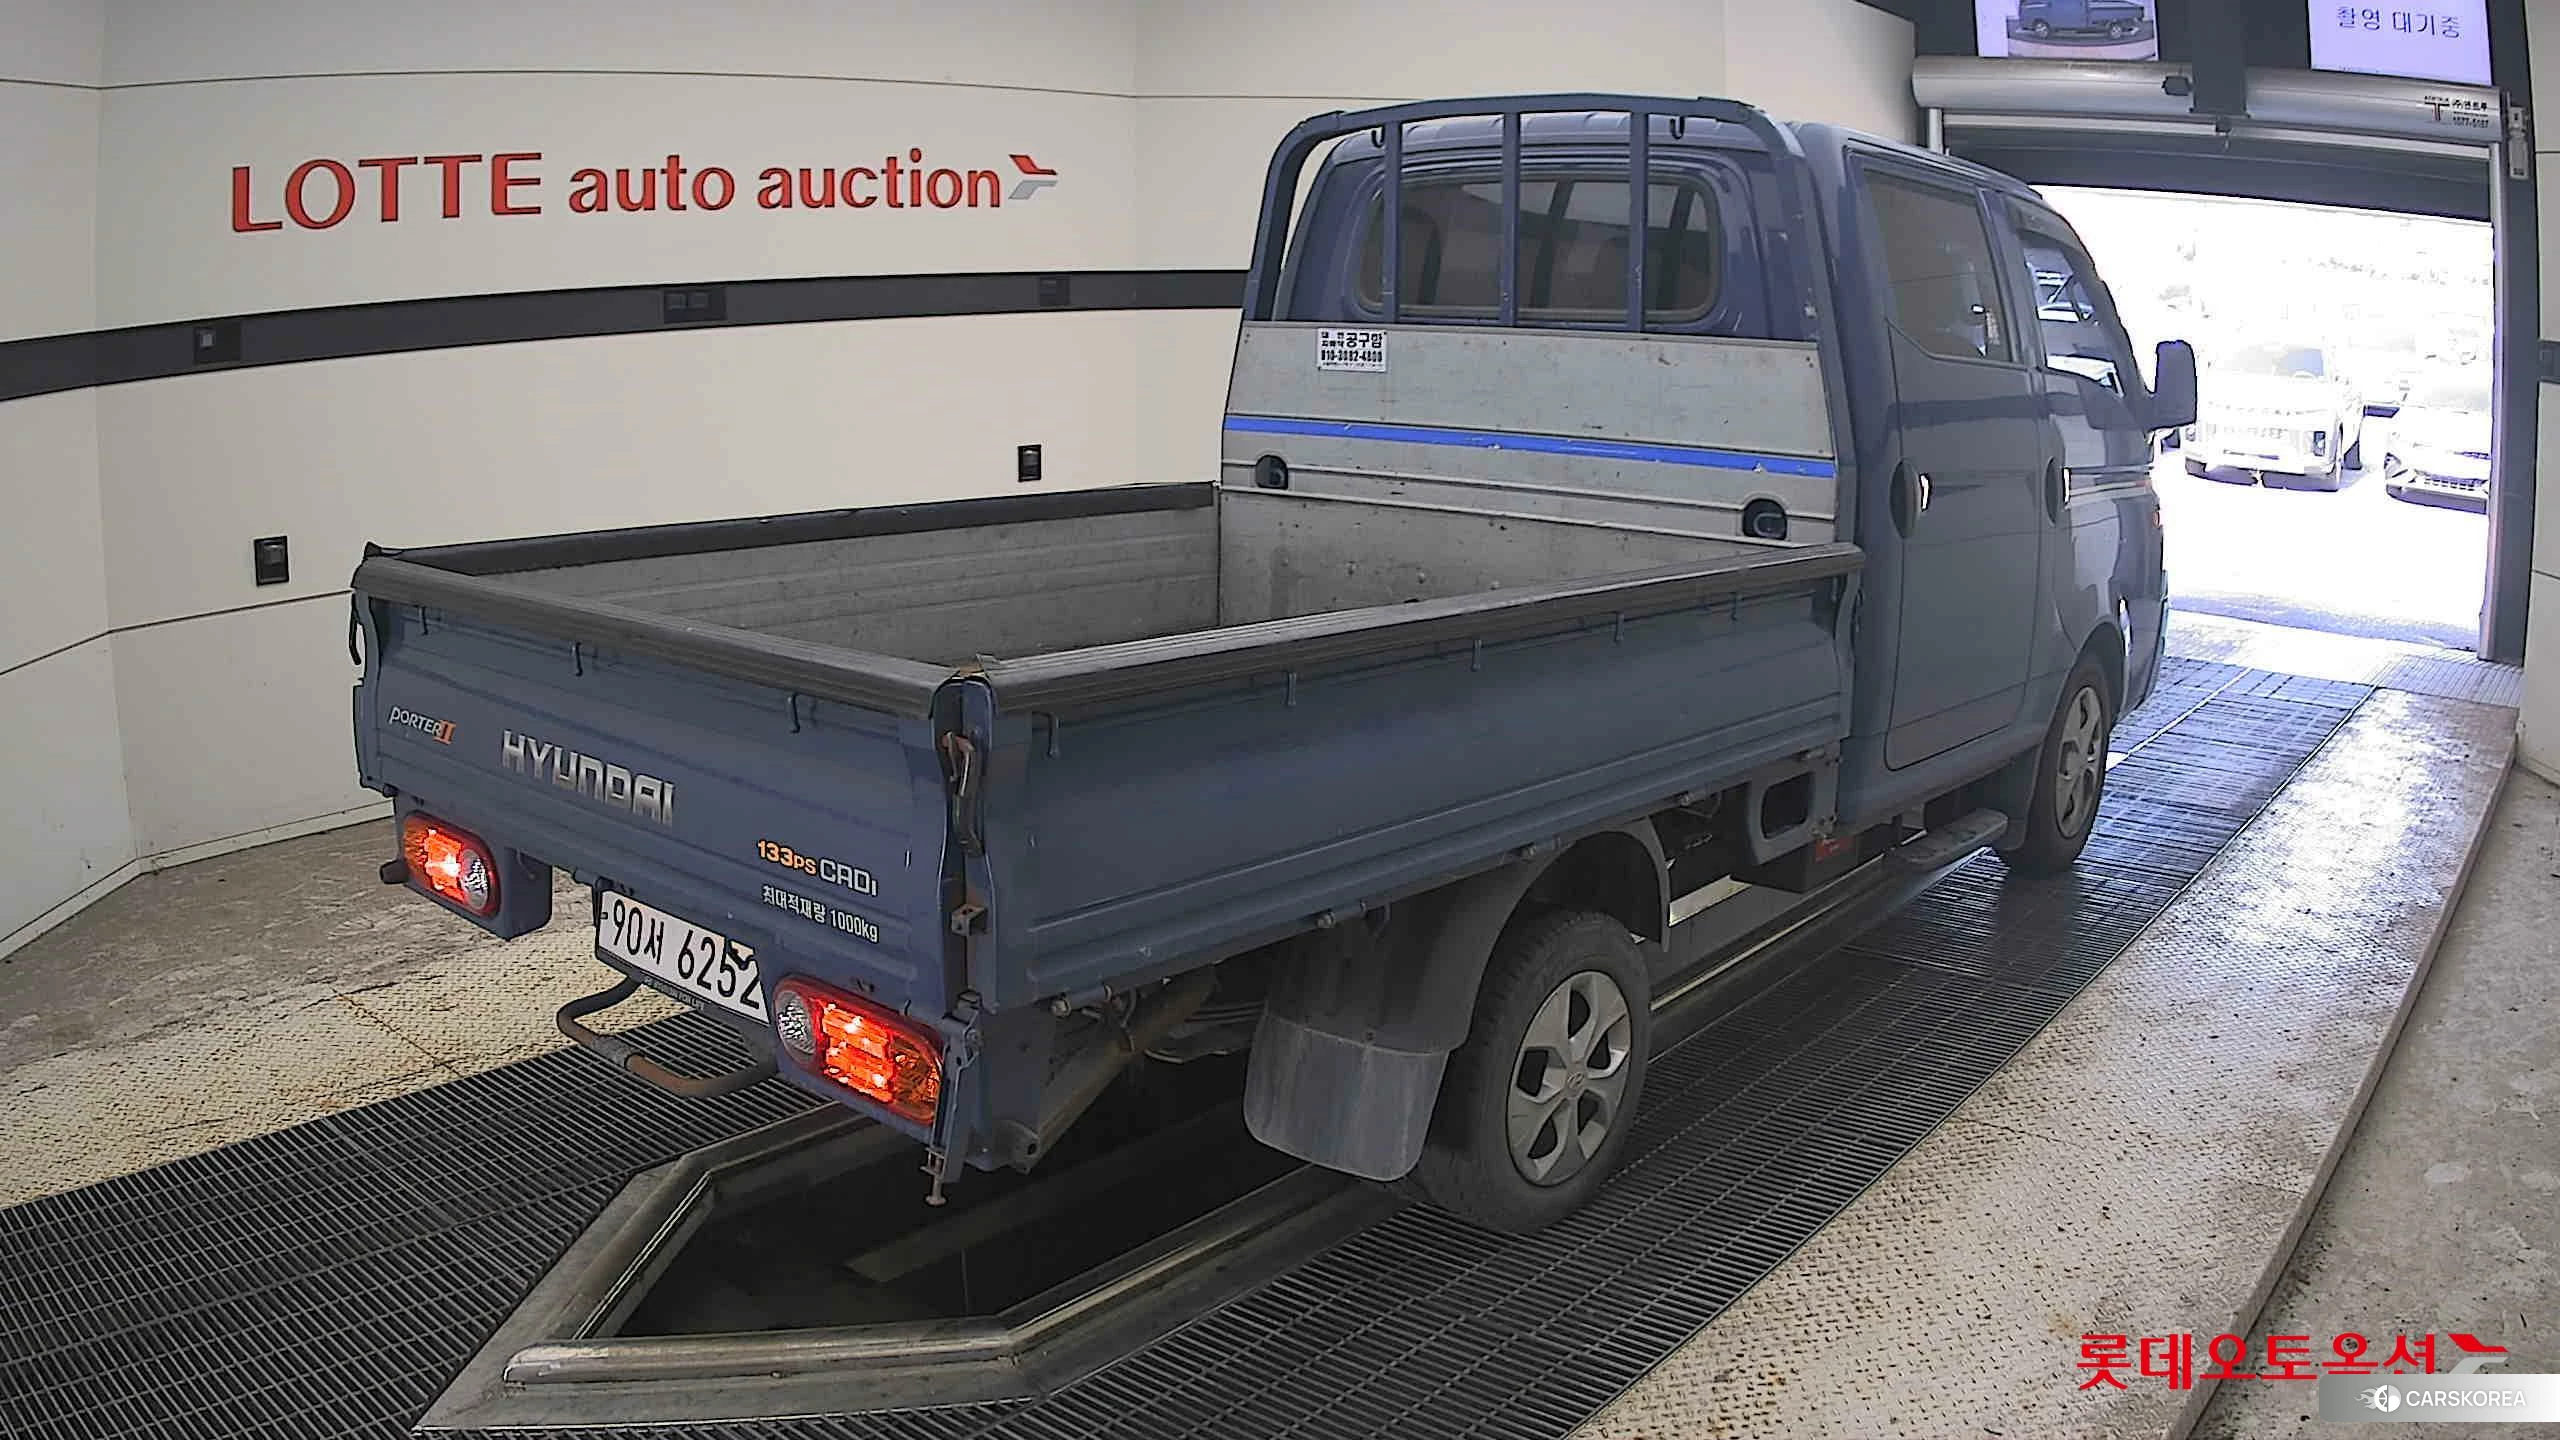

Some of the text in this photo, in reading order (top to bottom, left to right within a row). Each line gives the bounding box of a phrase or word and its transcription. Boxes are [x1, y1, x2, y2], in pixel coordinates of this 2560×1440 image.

[2337, 6, 2461, 38] 촬영 대기중
[232, 148, 1002, 233] LOTTE auto auction
[389, 706, 441, 737] PORTER
[502, 729, 676, 827] HYUNDAI
[757, 840, 817, 875] 133ps
[762, 885, 879, 943] 최대적재량 1000kg
[613, 899, 665, 965] 90서
[677, 930, 760, 1010] 6252
